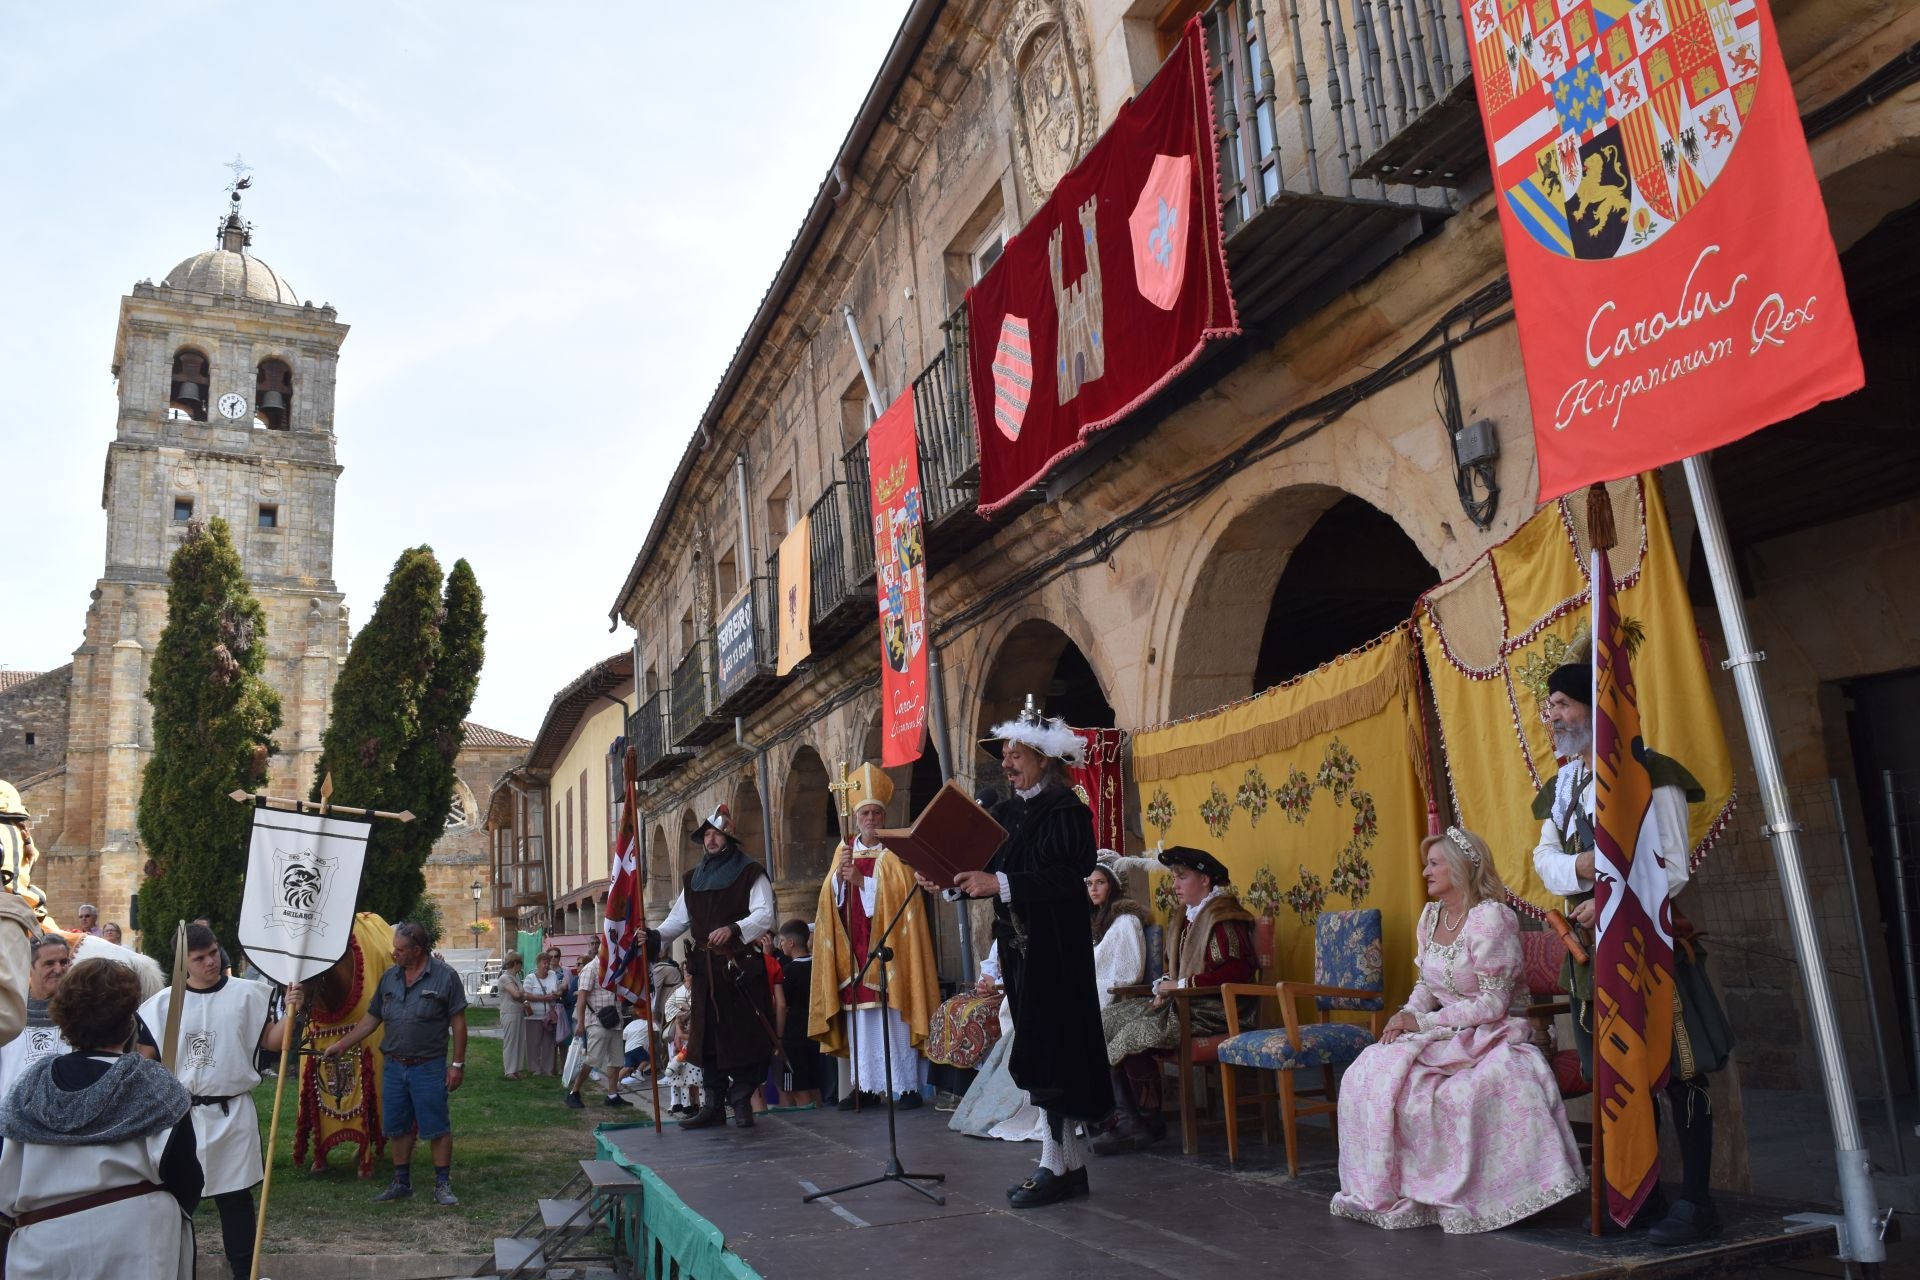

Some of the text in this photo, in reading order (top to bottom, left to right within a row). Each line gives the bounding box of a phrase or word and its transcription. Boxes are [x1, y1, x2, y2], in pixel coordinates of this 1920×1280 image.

[1555, 293, 1816, 430] Hispaniarum Rex
[1586, 245, 1747, 367] Carolus
